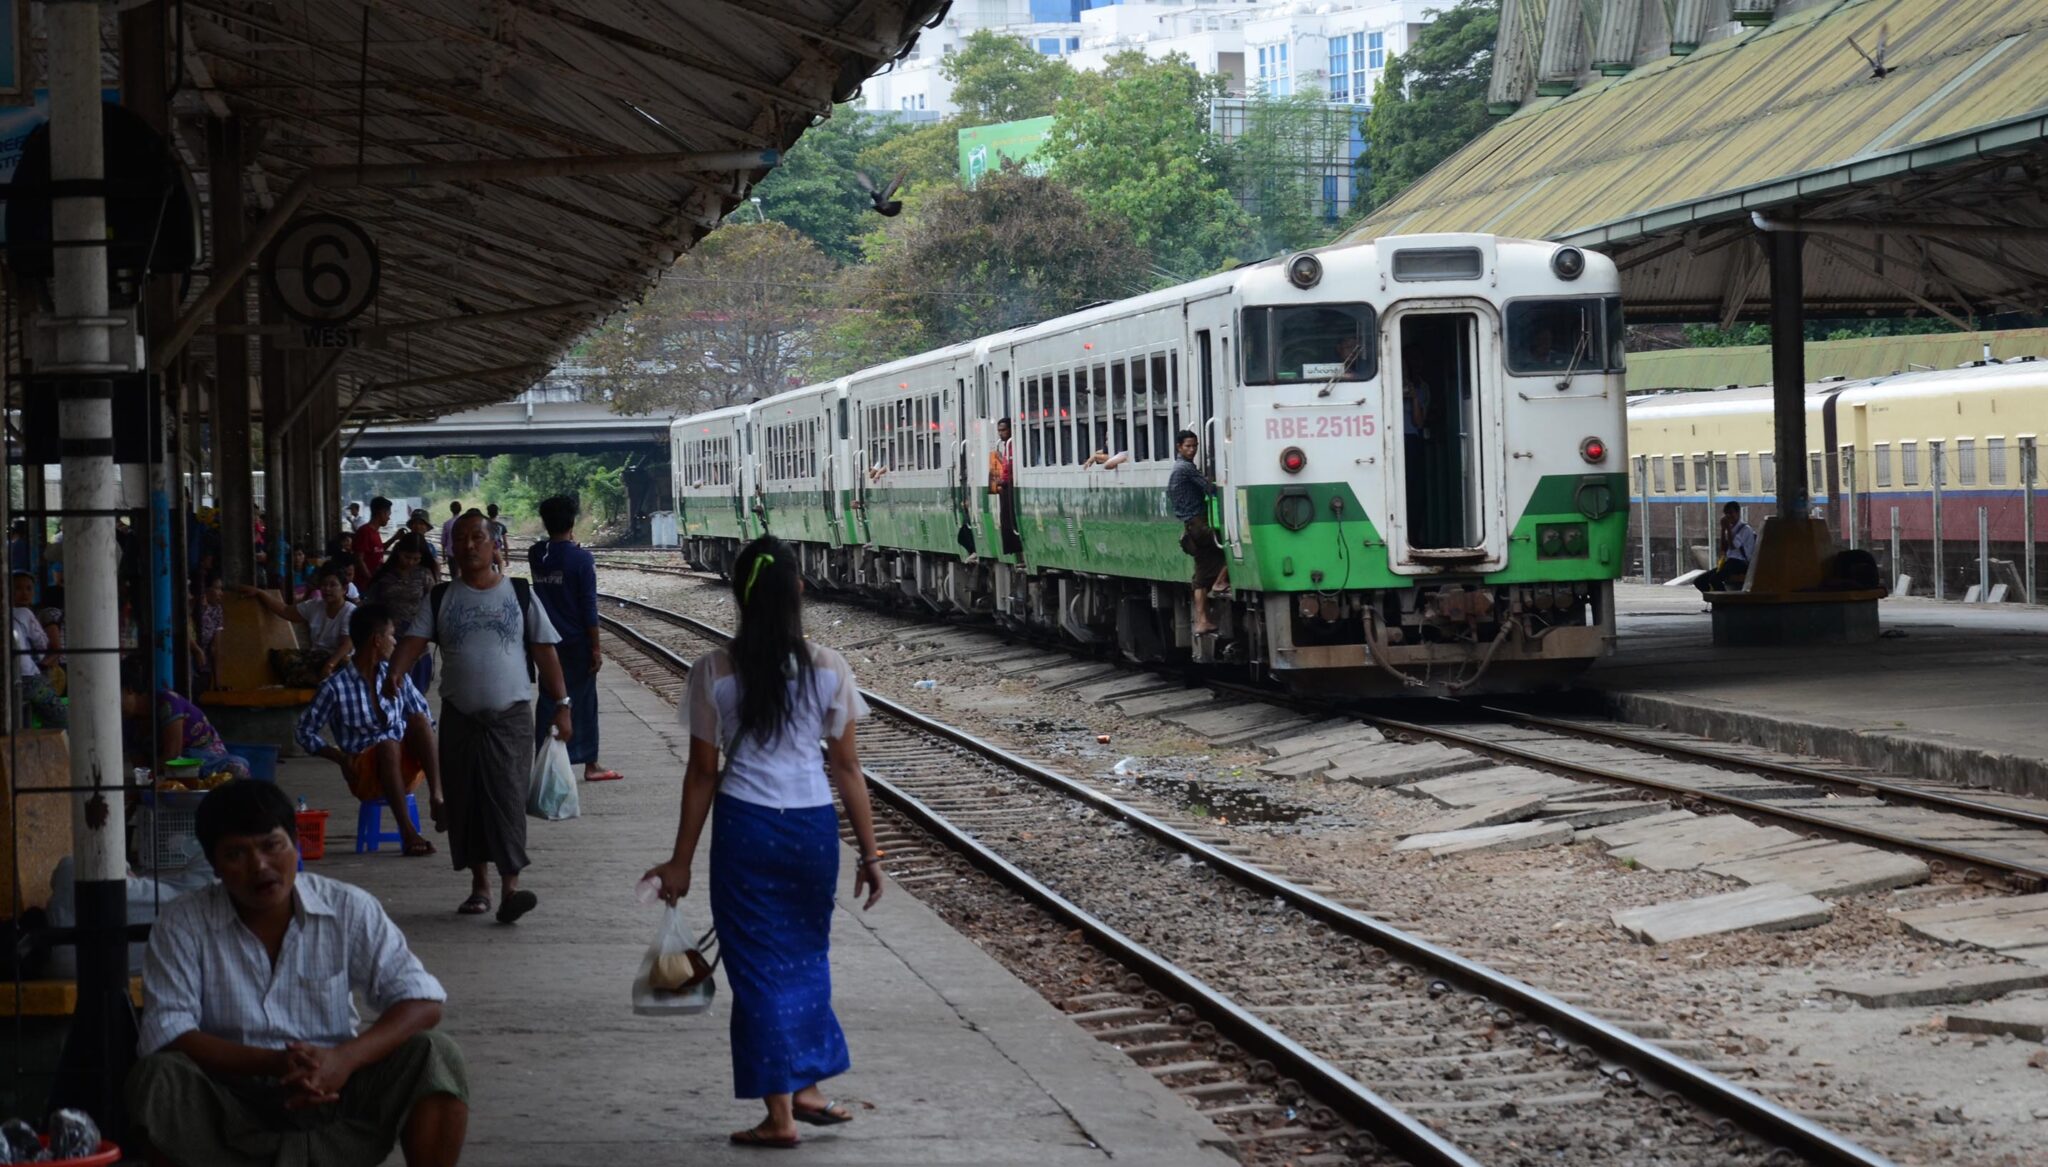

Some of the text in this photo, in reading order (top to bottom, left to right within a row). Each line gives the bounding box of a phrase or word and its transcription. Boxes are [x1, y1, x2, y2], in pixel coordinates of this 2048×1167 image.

[303, 234, 351, 307] 6
[303, 328, 361, 347] WEST
[1265, 414, 1376, 440] RBE.25115
